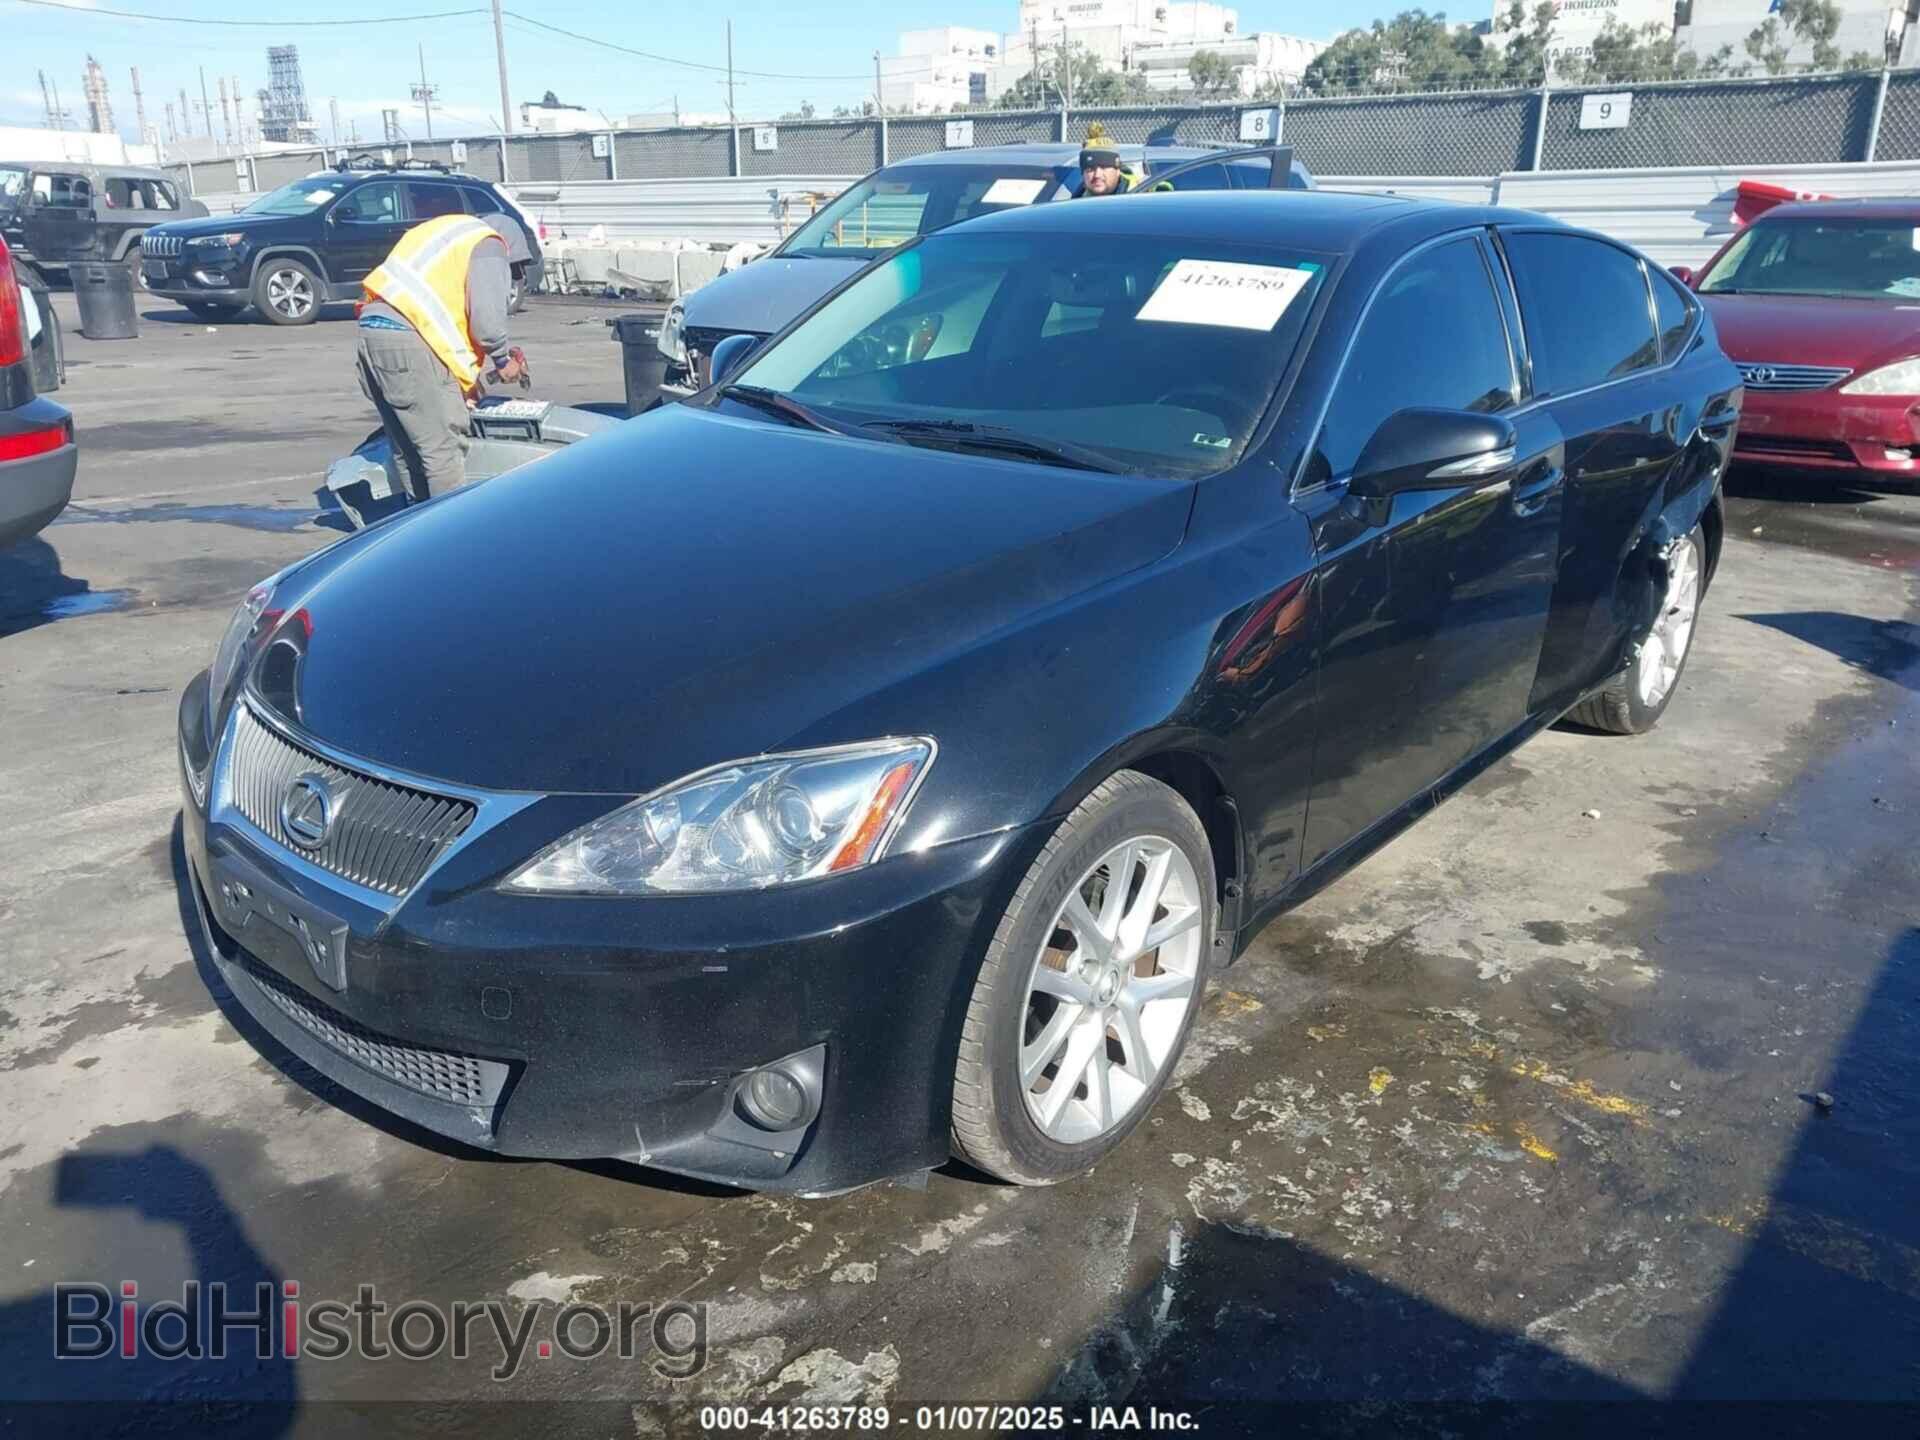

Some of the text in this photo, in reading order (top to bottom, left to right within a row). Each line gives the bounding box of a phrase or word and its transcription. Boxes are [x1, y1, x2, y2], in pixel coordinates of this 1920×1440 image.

[1564, 0, 1618, 10] HORIZON
[1600, 102, 1612, 119] 9
[1255, 116, 1264, 132] 8
[762, 132, 769, 145] 6
[955, 127, 963, 140] 7
[1178, 273, 1286, 291] 41263789
